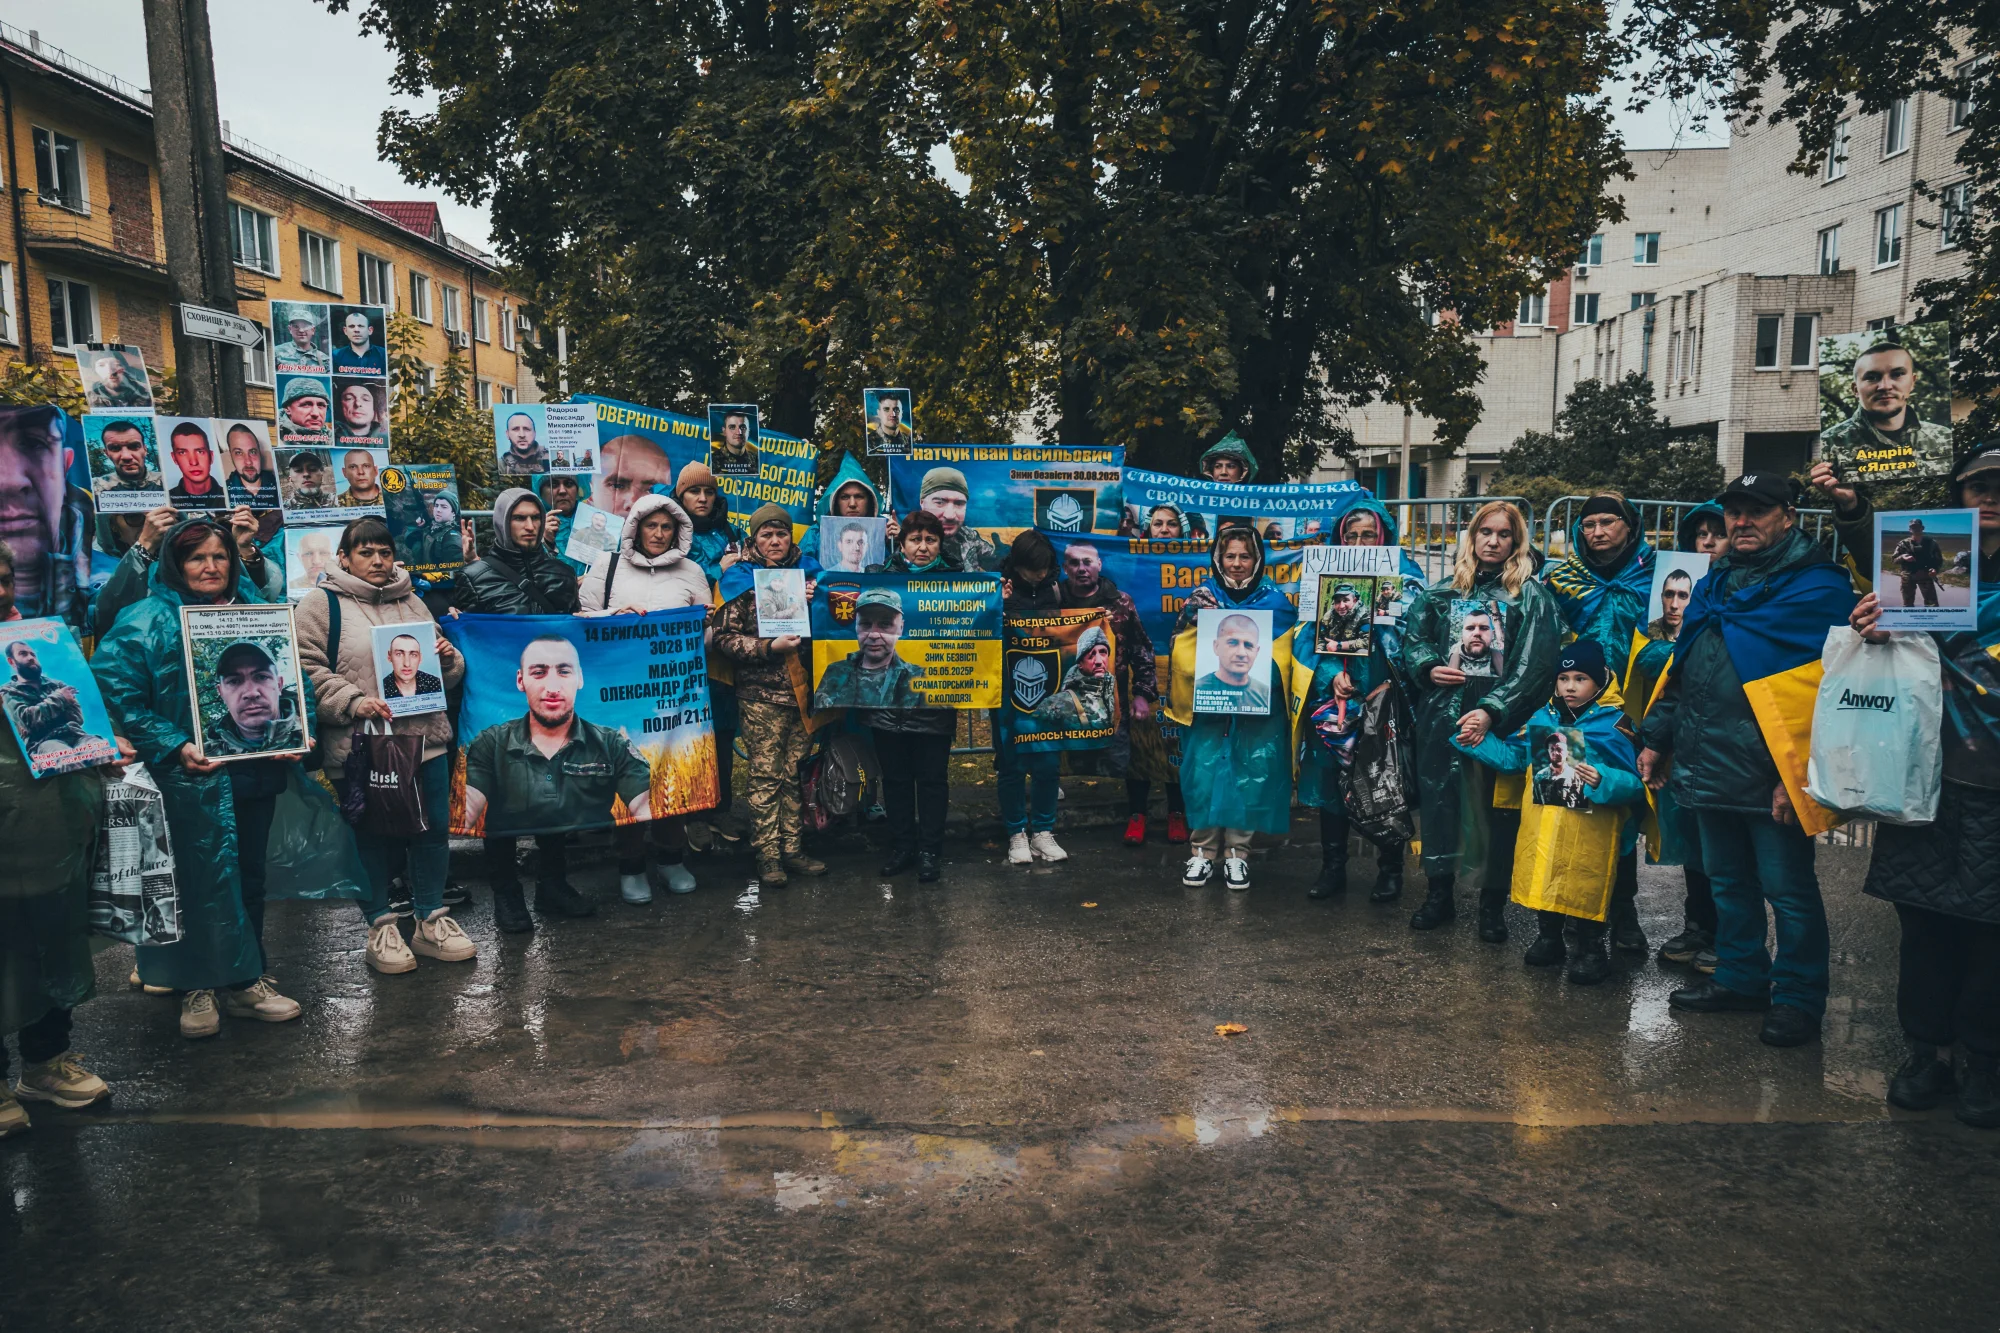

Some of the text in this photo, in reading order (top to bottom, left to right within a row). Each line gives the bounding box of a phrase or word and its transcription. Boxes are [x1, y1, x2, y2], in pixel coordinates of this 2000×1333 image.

[186, 311, 224, 326] СХОВИЩЕ
[973, 448, 1009, 461] Іван
[1012, 448, 1112, 463] Васильович
[1856, 446, 1914, 460] Андрій
[1857, 460, 1917, 473] «Ялта»
[411, 470, 452, 480] Позивний
[760, 463, 816, 489] БОГДАН
[1010, 469, 1120, 481] Зник безвісти 30.08.2025
[1303, 481, 1361, 493] ЧЕКАЄ
[100, 492, 139, 500] Олександр
[1146, 489, 1337, 511] СВОЇХ ГЕРОЇВ ДОДОМУ
[1305, 547, 1394, 574] КУРЩИНА
[907, 580, 997, 593] ПРІКОТА МИКОЛА
[917, 599, 987, 613] ВАСИЛЬОВИЧ
[961, 617, 974, 625] ЗСУ
[584, 628, 600, 642] 14
[601, 623, 660, 641] БРИГАДА
[939, 629, 993, 638] ГРАНАТОМЕТНИК
[649, 640, 683, 655] 3028
[929, 642, 956, 650] ЧАСТИНА
[1021, 636, 1050, 648] ОТБр
[924, 652, 978, 662] ЗНИК БЕЗВІСТІ
[927, 666, 974, 676] 05.05.2025Р
[912, 679, 989, 690] КРАМАТОРСЬКИЙ Р-Н
[600, 680, 681, 703] ОЛЕКСАНДР
[1065, 727, 1115, 740] ЧЕКАЄМО
